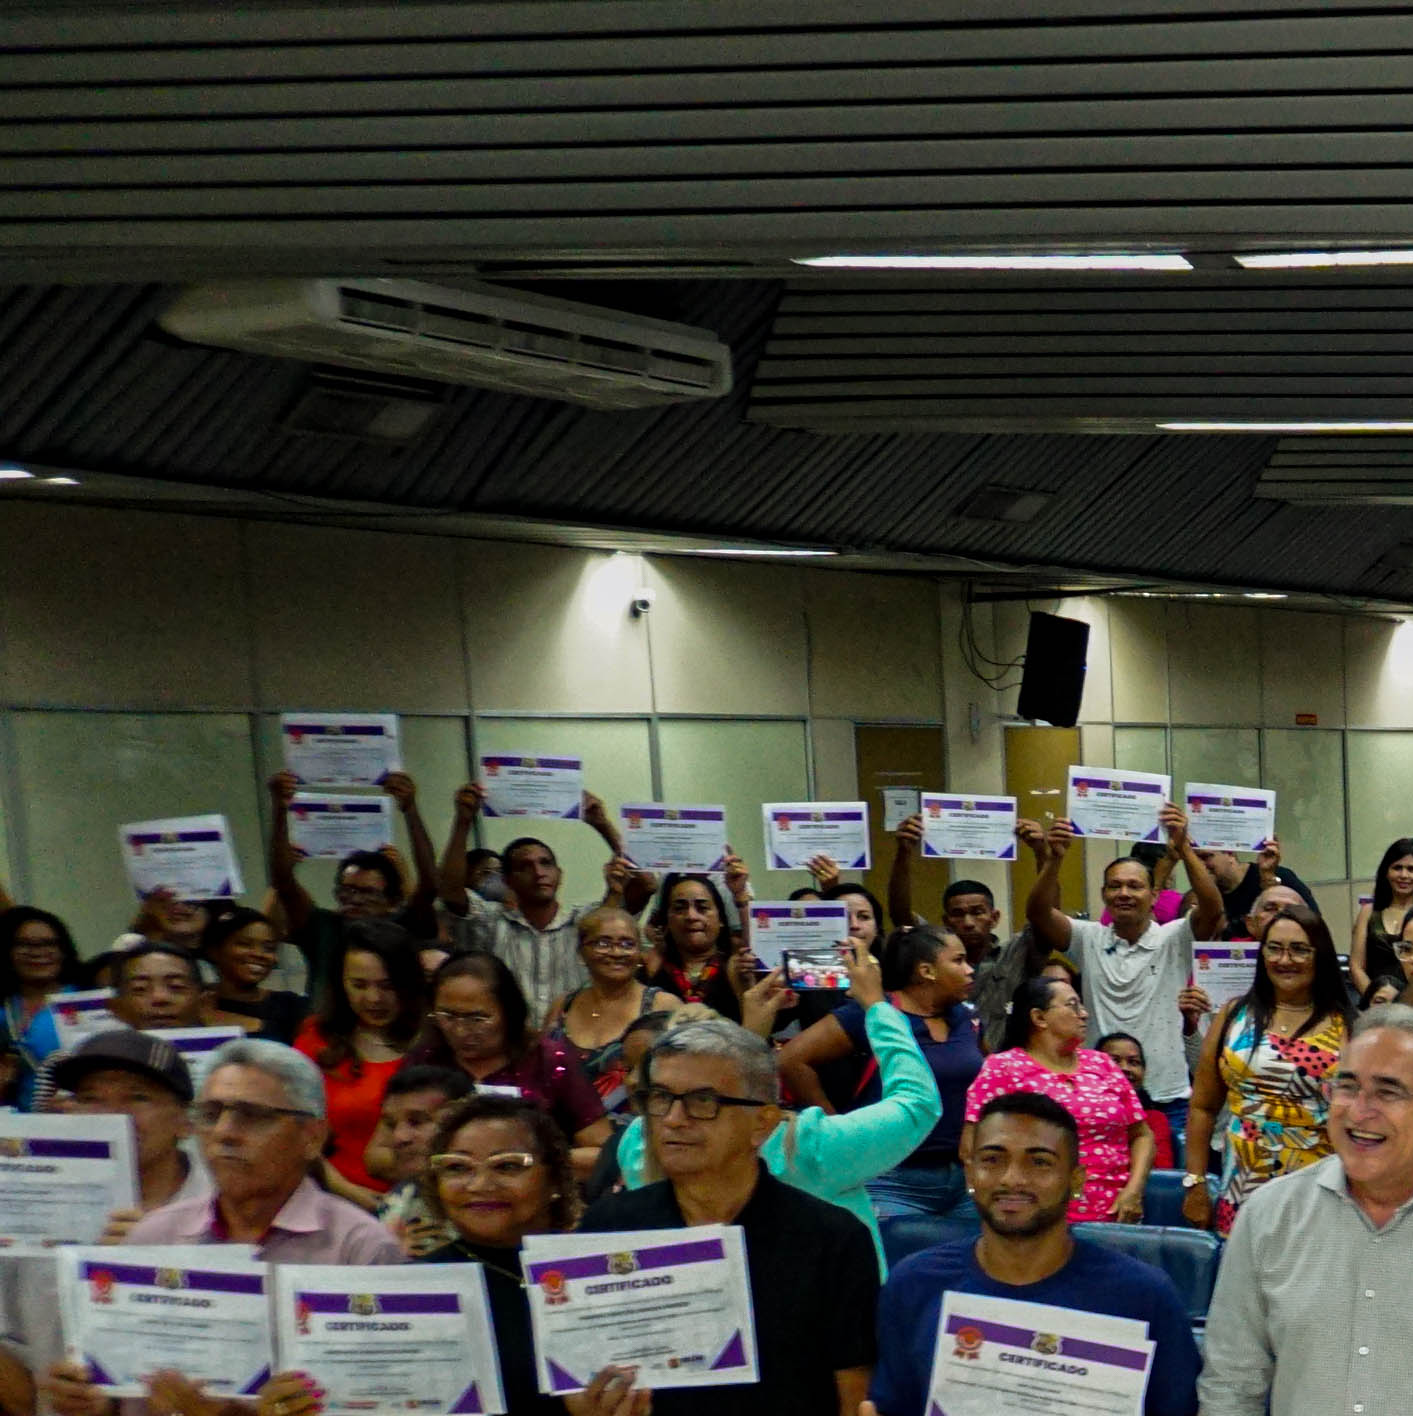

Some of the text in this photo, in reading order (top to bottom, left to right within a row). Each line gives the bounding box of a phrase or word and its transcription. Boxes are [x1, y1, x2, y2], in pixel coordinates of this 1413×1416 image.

[585, 1275, 673, 1295] CERTIFICADO
[325, 1322, 411, 1331] CERTIFICADO
[999, 1352, 1088, 1375] CERTIFICADO
